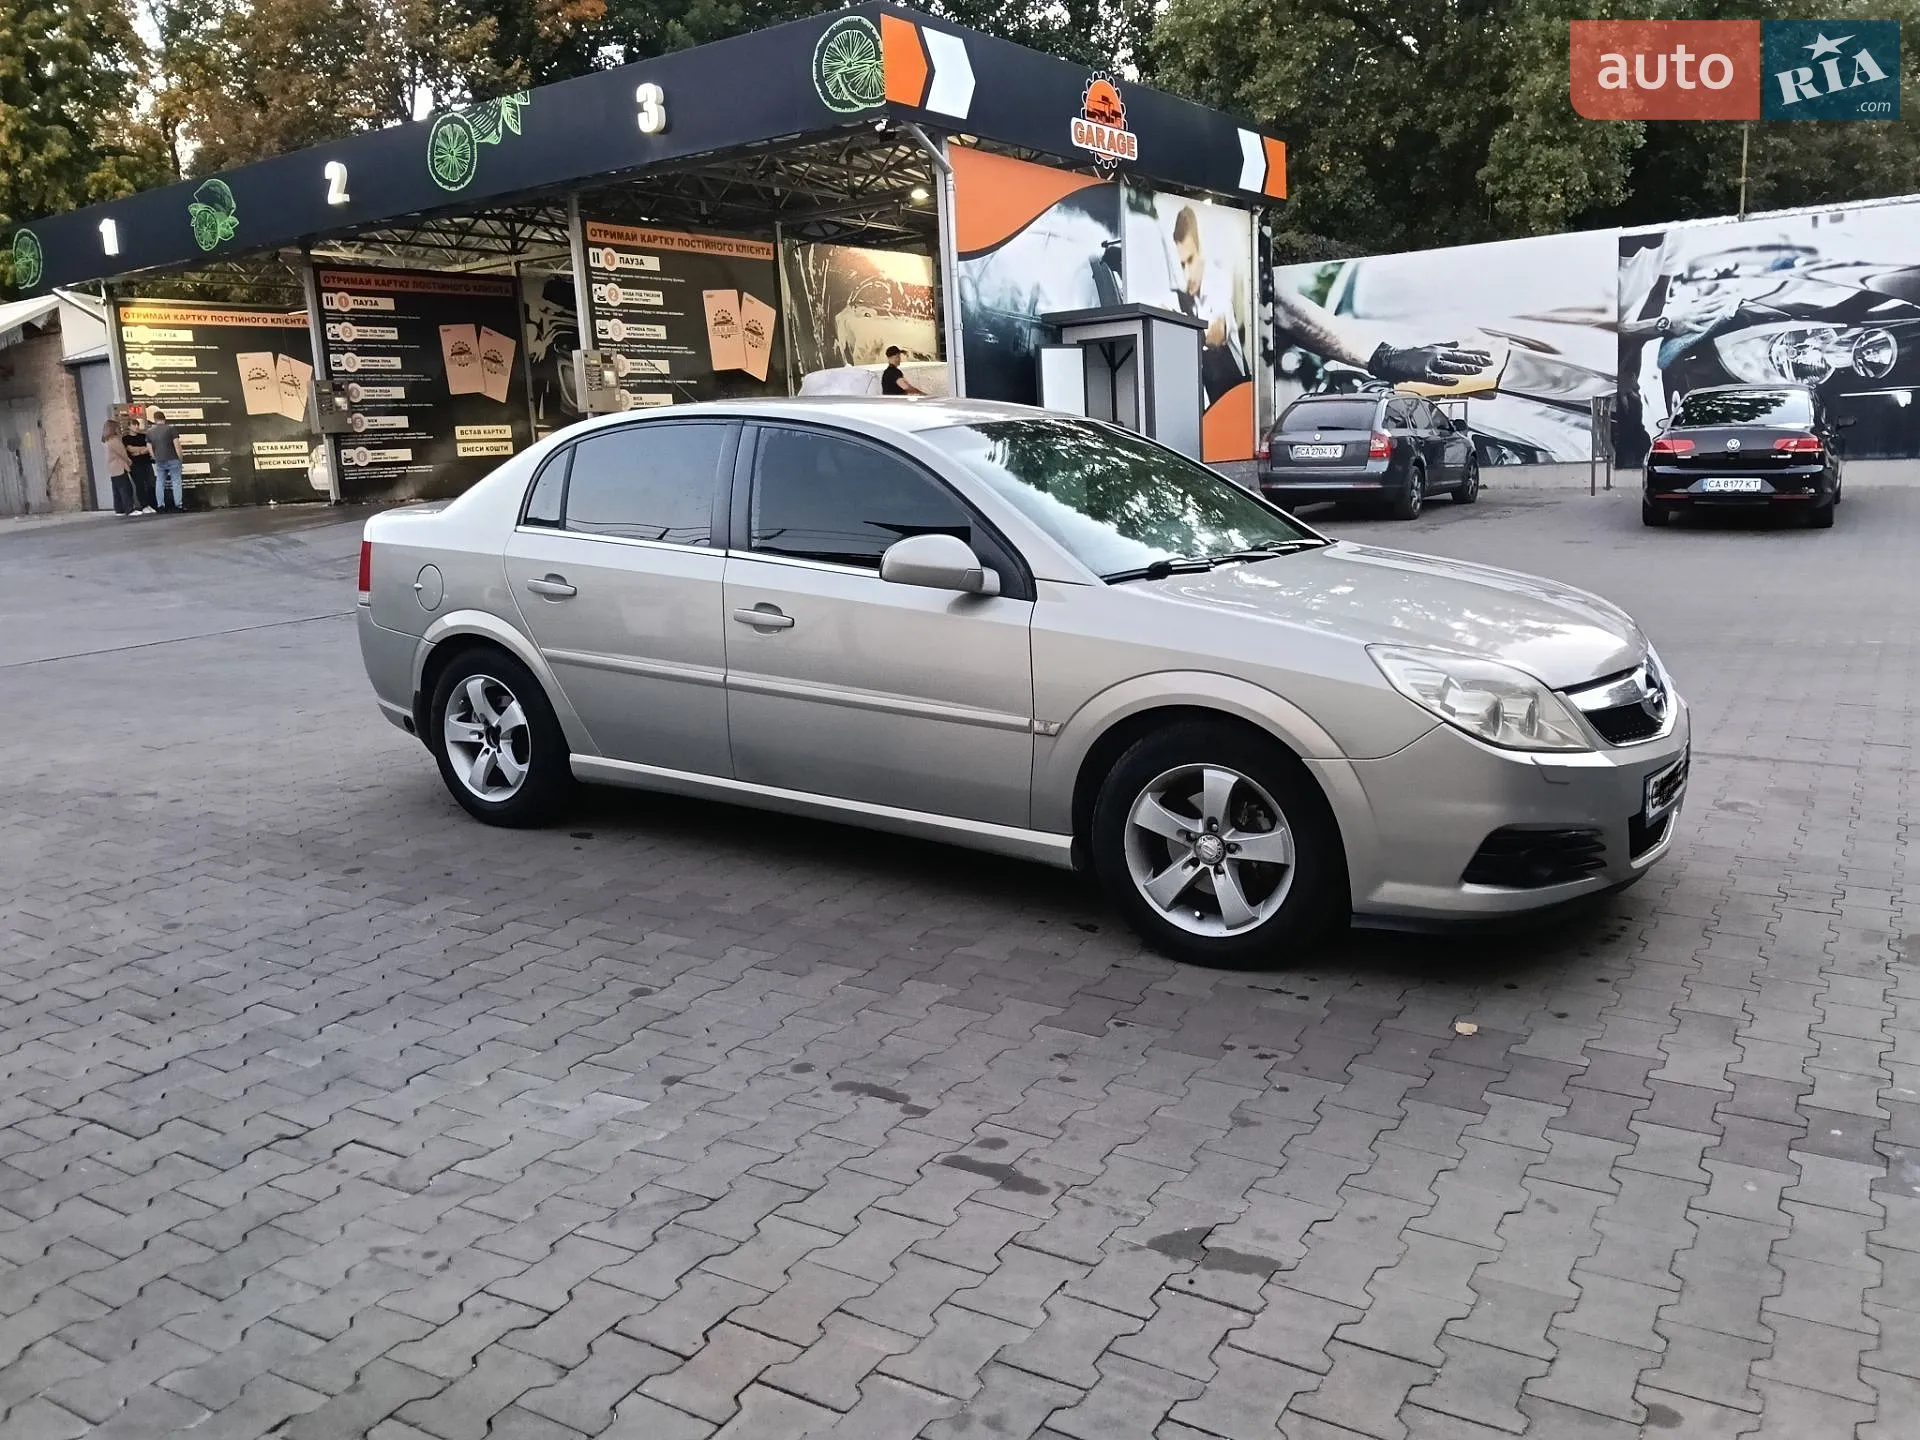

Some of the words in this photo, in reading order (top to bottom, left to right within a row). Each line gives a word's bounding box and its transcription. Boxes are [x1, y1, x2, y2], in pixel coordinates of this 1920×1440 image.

[636, 82, 666, 133] 3
[1073, 121, 1136, 158] GARAGE
[324, 161, 350, 205] 2
[99, 218, 119, 256] 1
[640, 233, 675, 246] КАРТКУ
[619, 256, 645, 266] ПАУЗА
[374, 277, 410, 289] КАРТКУ
[352, 298, 380, 308] ПАУЗА
[173, 313, 209, 323] КАРТКУ
[460, 428, 482, 436] ВСТАВ
[483, 428, 507, 436] КАРТКУ
[279, 443, 304, 451] КАРТКУ
[485, 444, 509, 452] КОШТИ
[282, 458, 306, 466] КОШТИ
[1708, 480, 1721, 489] CA
[1723, 480, 1744, 489] 8177
